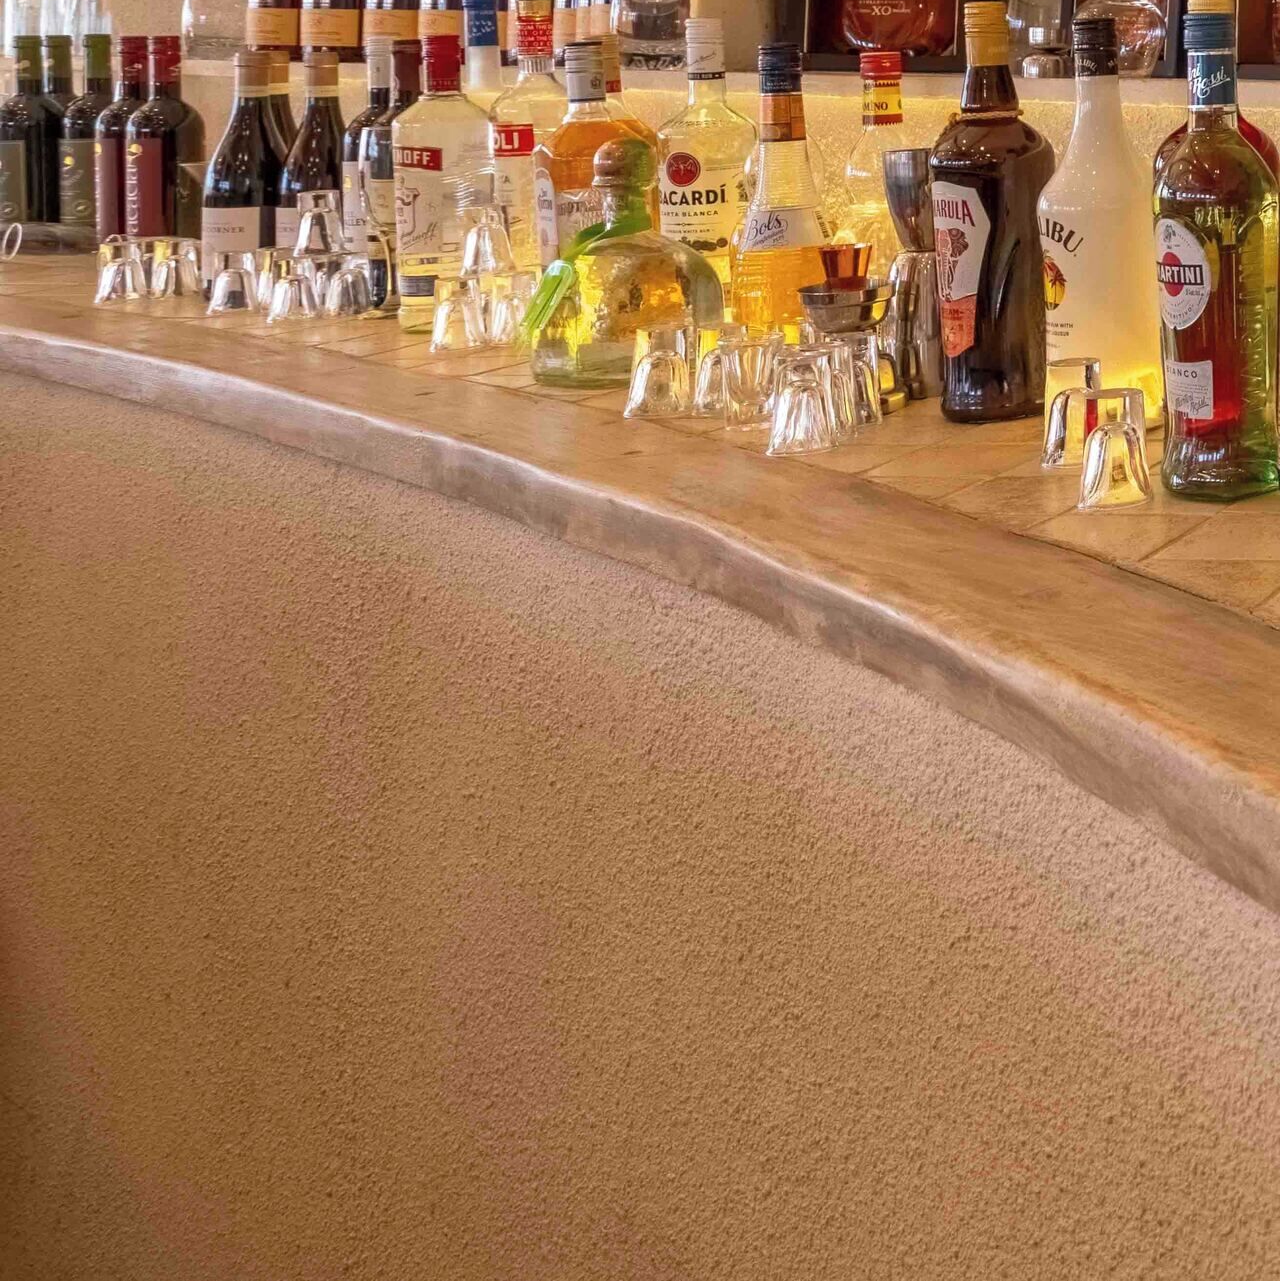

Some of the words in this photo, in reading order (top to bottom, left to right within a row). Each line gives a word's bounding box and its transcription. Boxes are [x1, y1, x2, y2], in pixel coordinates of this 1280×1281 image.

[871, 6, 892, 16] XO
[681, 208, 719, 218] BLANCA
[747, 210, 783, 241] Bols
[1038, 216, 1084, 255] LIBU
